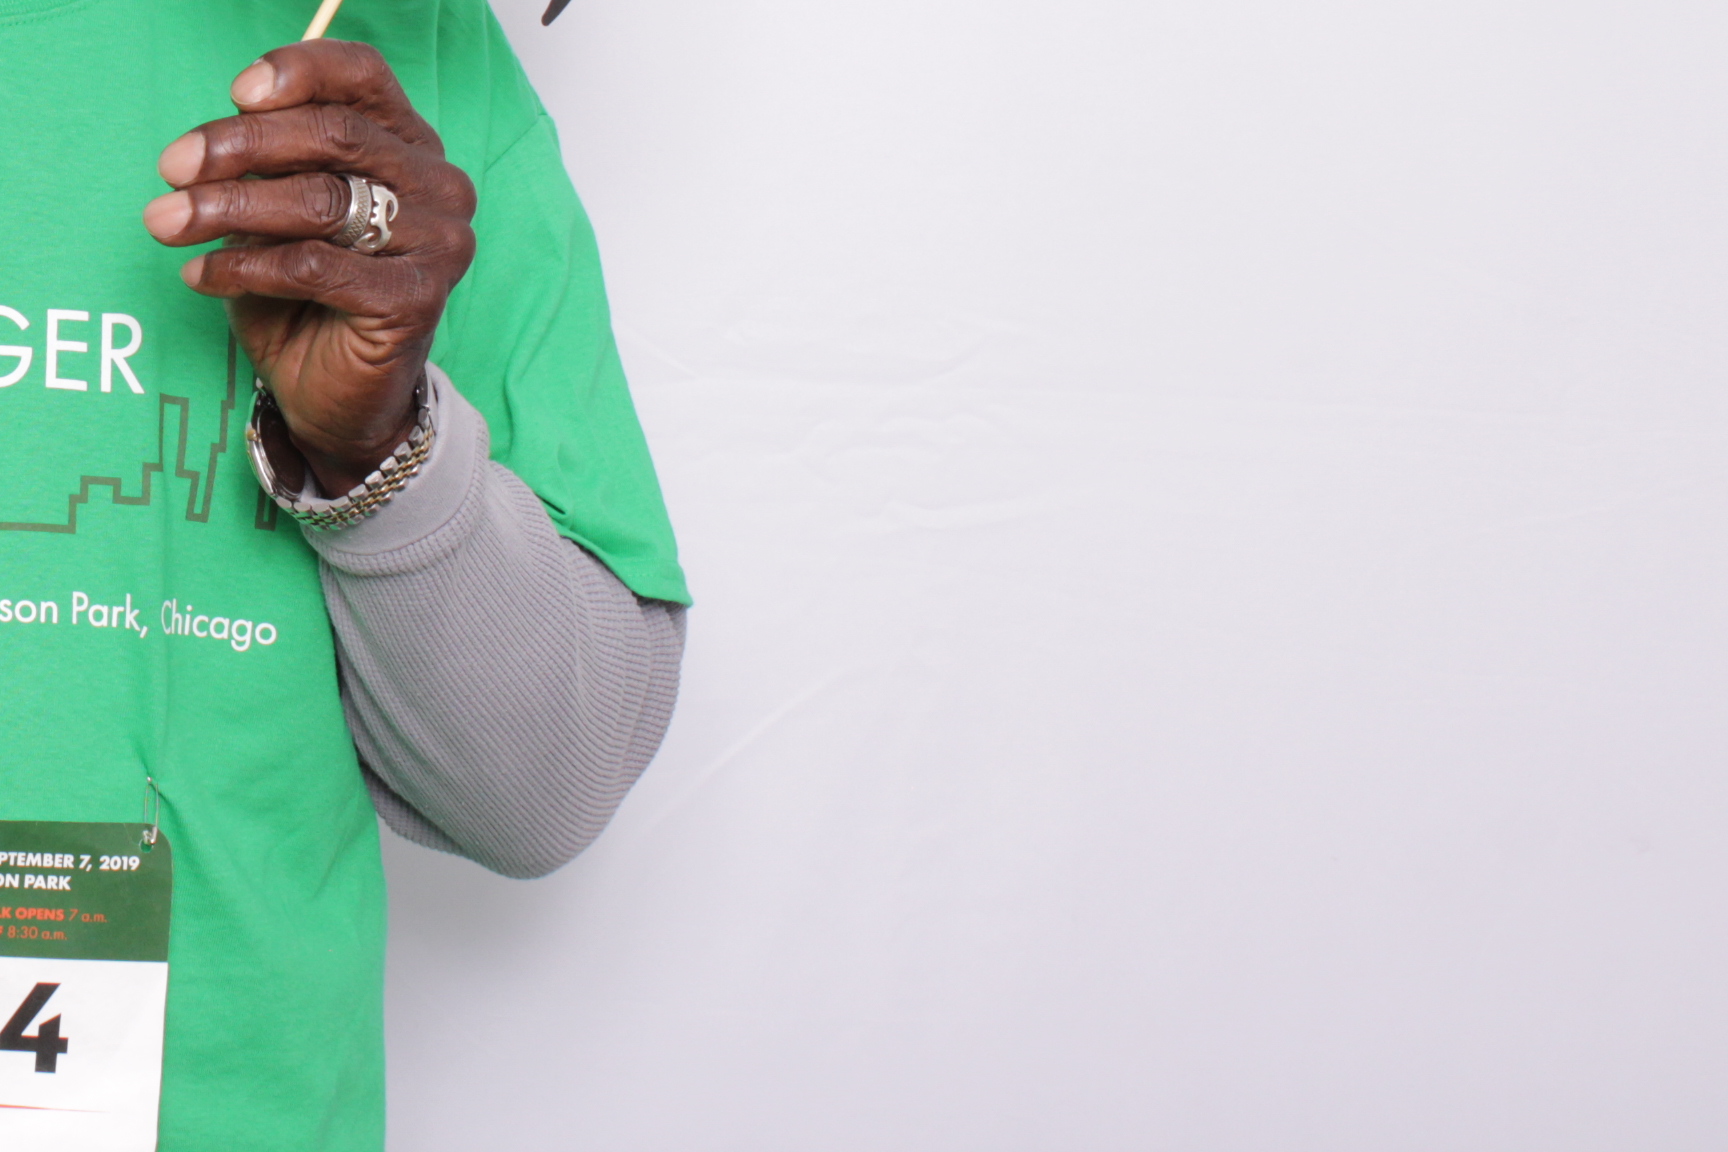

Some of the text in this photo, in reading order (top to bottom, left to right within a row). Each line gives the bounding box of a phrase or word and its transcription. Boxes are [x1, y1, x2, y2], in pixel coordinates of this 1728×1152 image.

[71, 591, 149, 639] Park,
[160, 598, 278, 652] Chicago
[77, 854, 93, 872] 7,
[98, 855, 141, 871] 2019
[23, 874, 72, 891] PARK
[15, 907, 65, 922] OPENS
[68, 909, 79, 921] 7
[81, 912, 108, 923] a.m.
[7, 925, 39, 939] 8:30
[41, 930, 68, 940] a.m.
